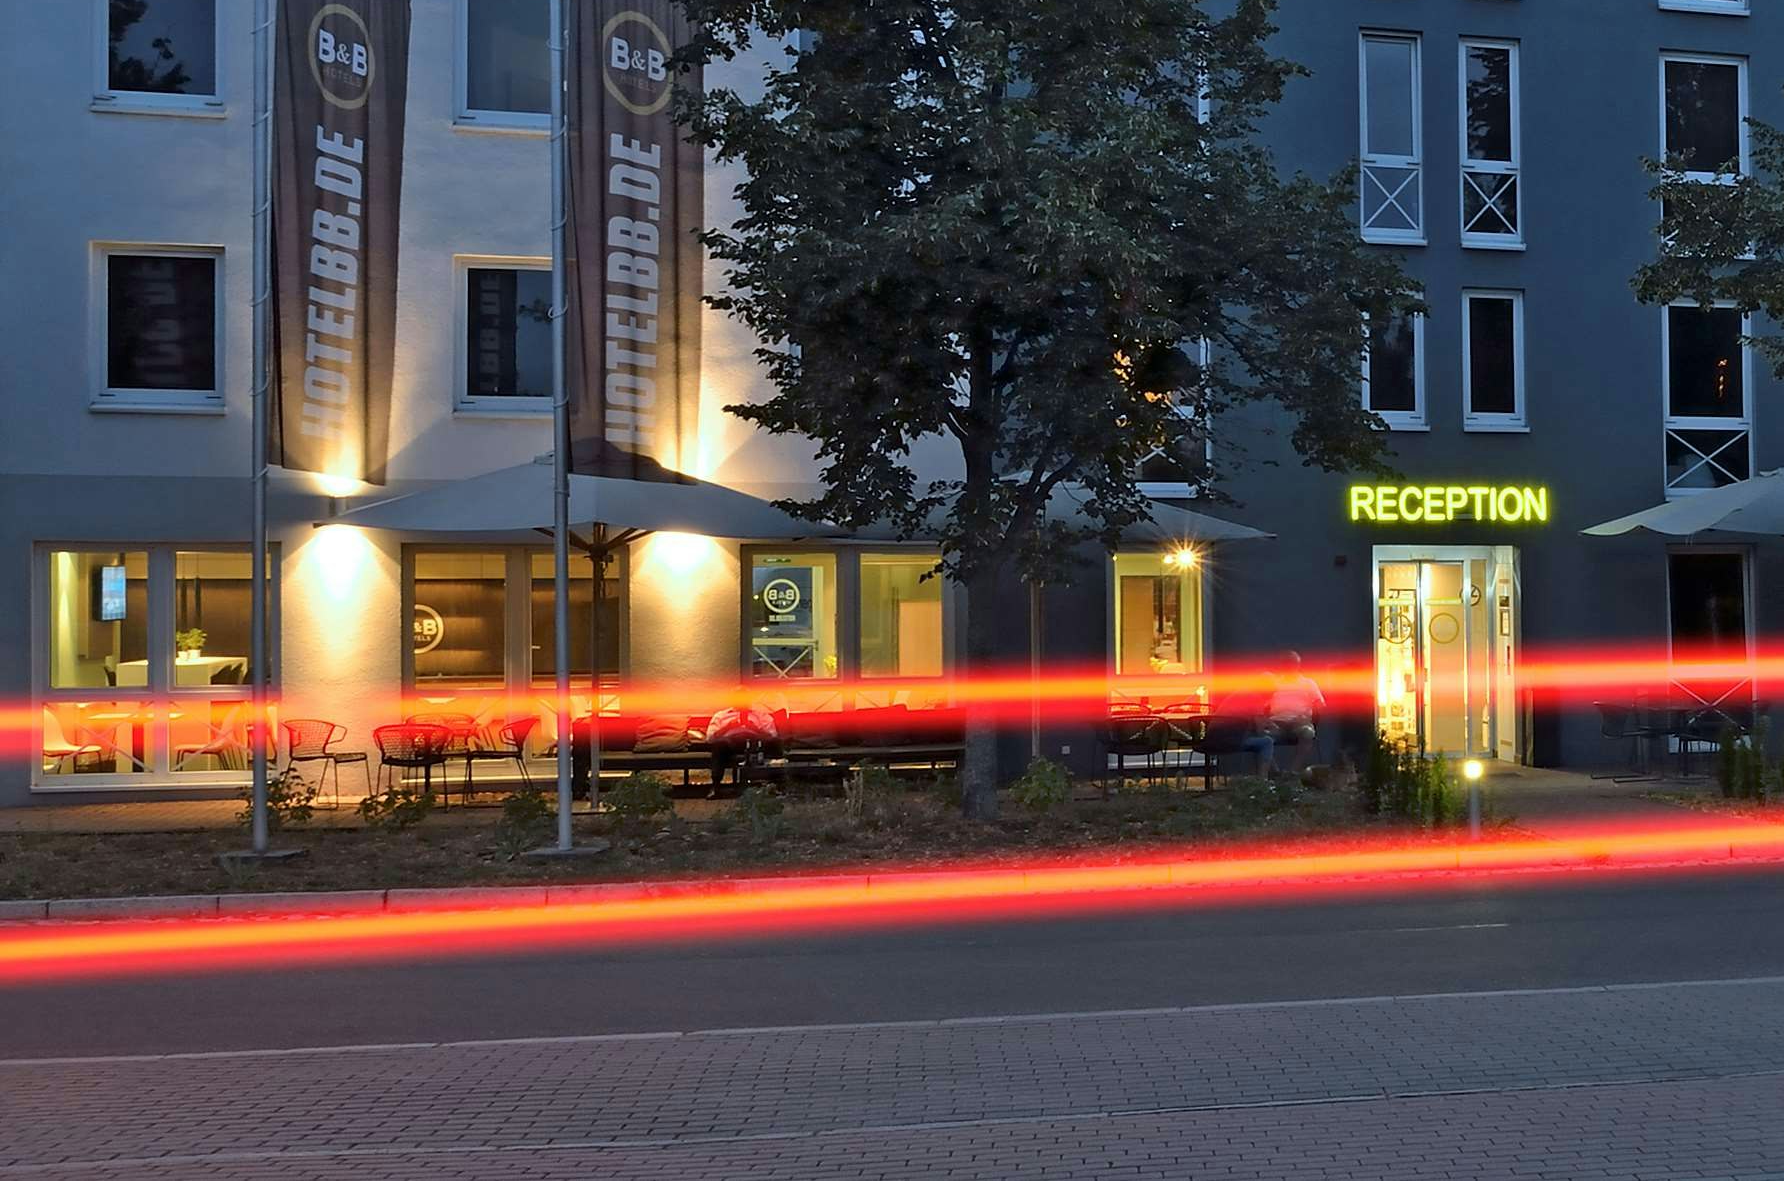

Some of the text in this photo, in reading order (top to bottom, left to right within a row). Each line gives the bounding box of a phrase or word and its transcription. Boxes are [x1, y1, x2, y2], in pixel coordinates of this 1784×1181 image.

[319, 28, 368, 76] B&B
[612, 37, 666, 81] B&B
[300, 125, 364, 437] HOTELBB.DE
[605, 132, 662, 445] HOTELBB.DE
[1350, 486, 1548, 521] RECEPTION
[414, 619, 438, 636] &B
